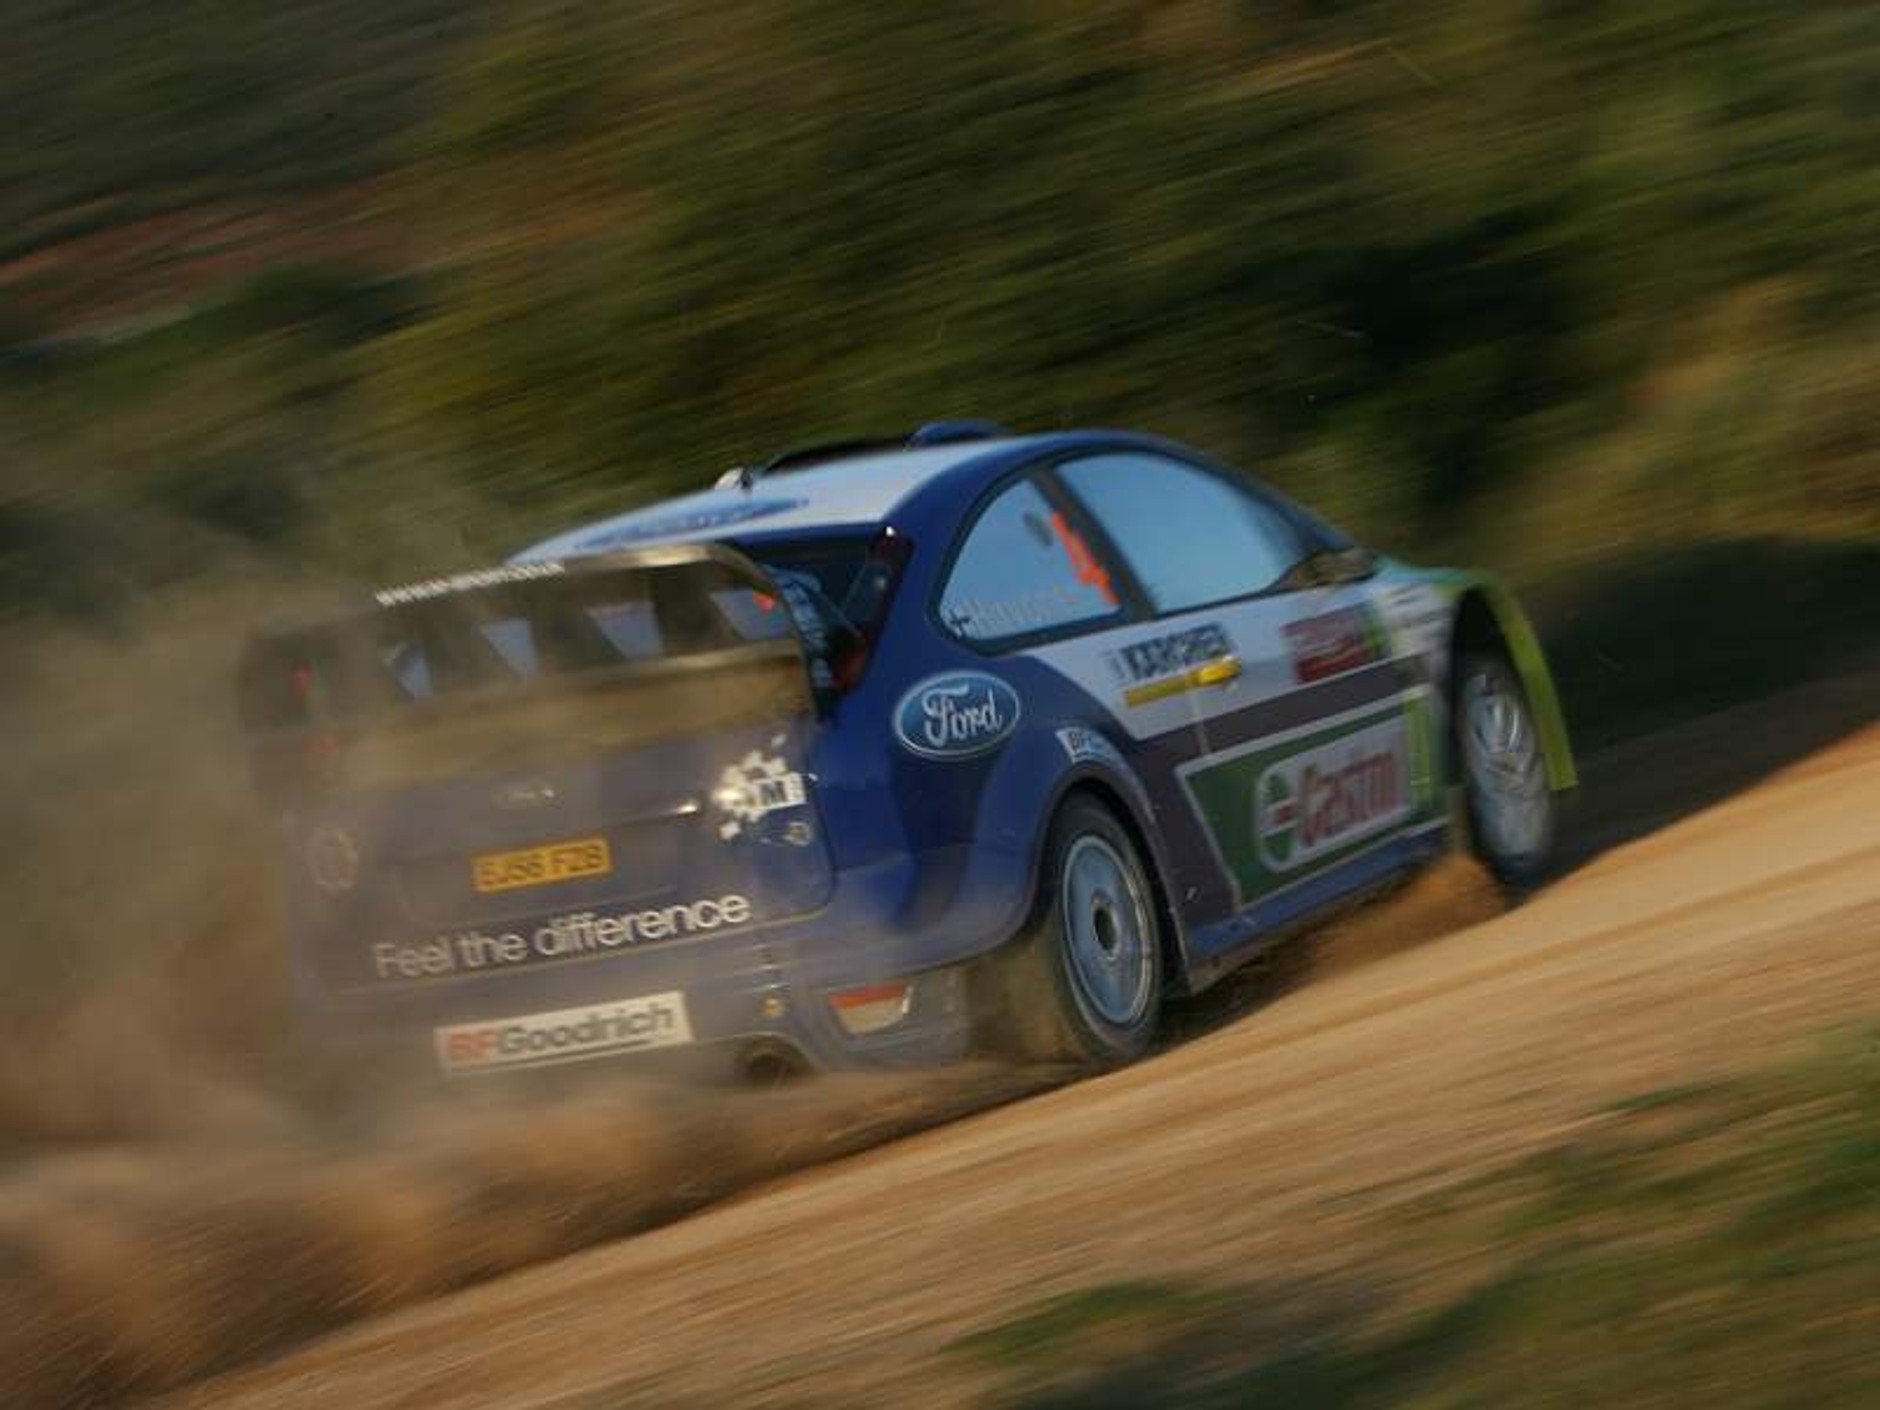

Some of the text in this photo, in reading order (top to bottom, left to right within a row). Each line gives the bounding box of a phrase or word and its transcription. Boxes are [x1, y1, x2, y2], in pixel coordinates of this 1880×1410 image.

[921, 683, 1003, 748] Ford
[373, 893, 753, 979] Feel the difference
[446, 1003, 675, 1064] BFGoodrich
